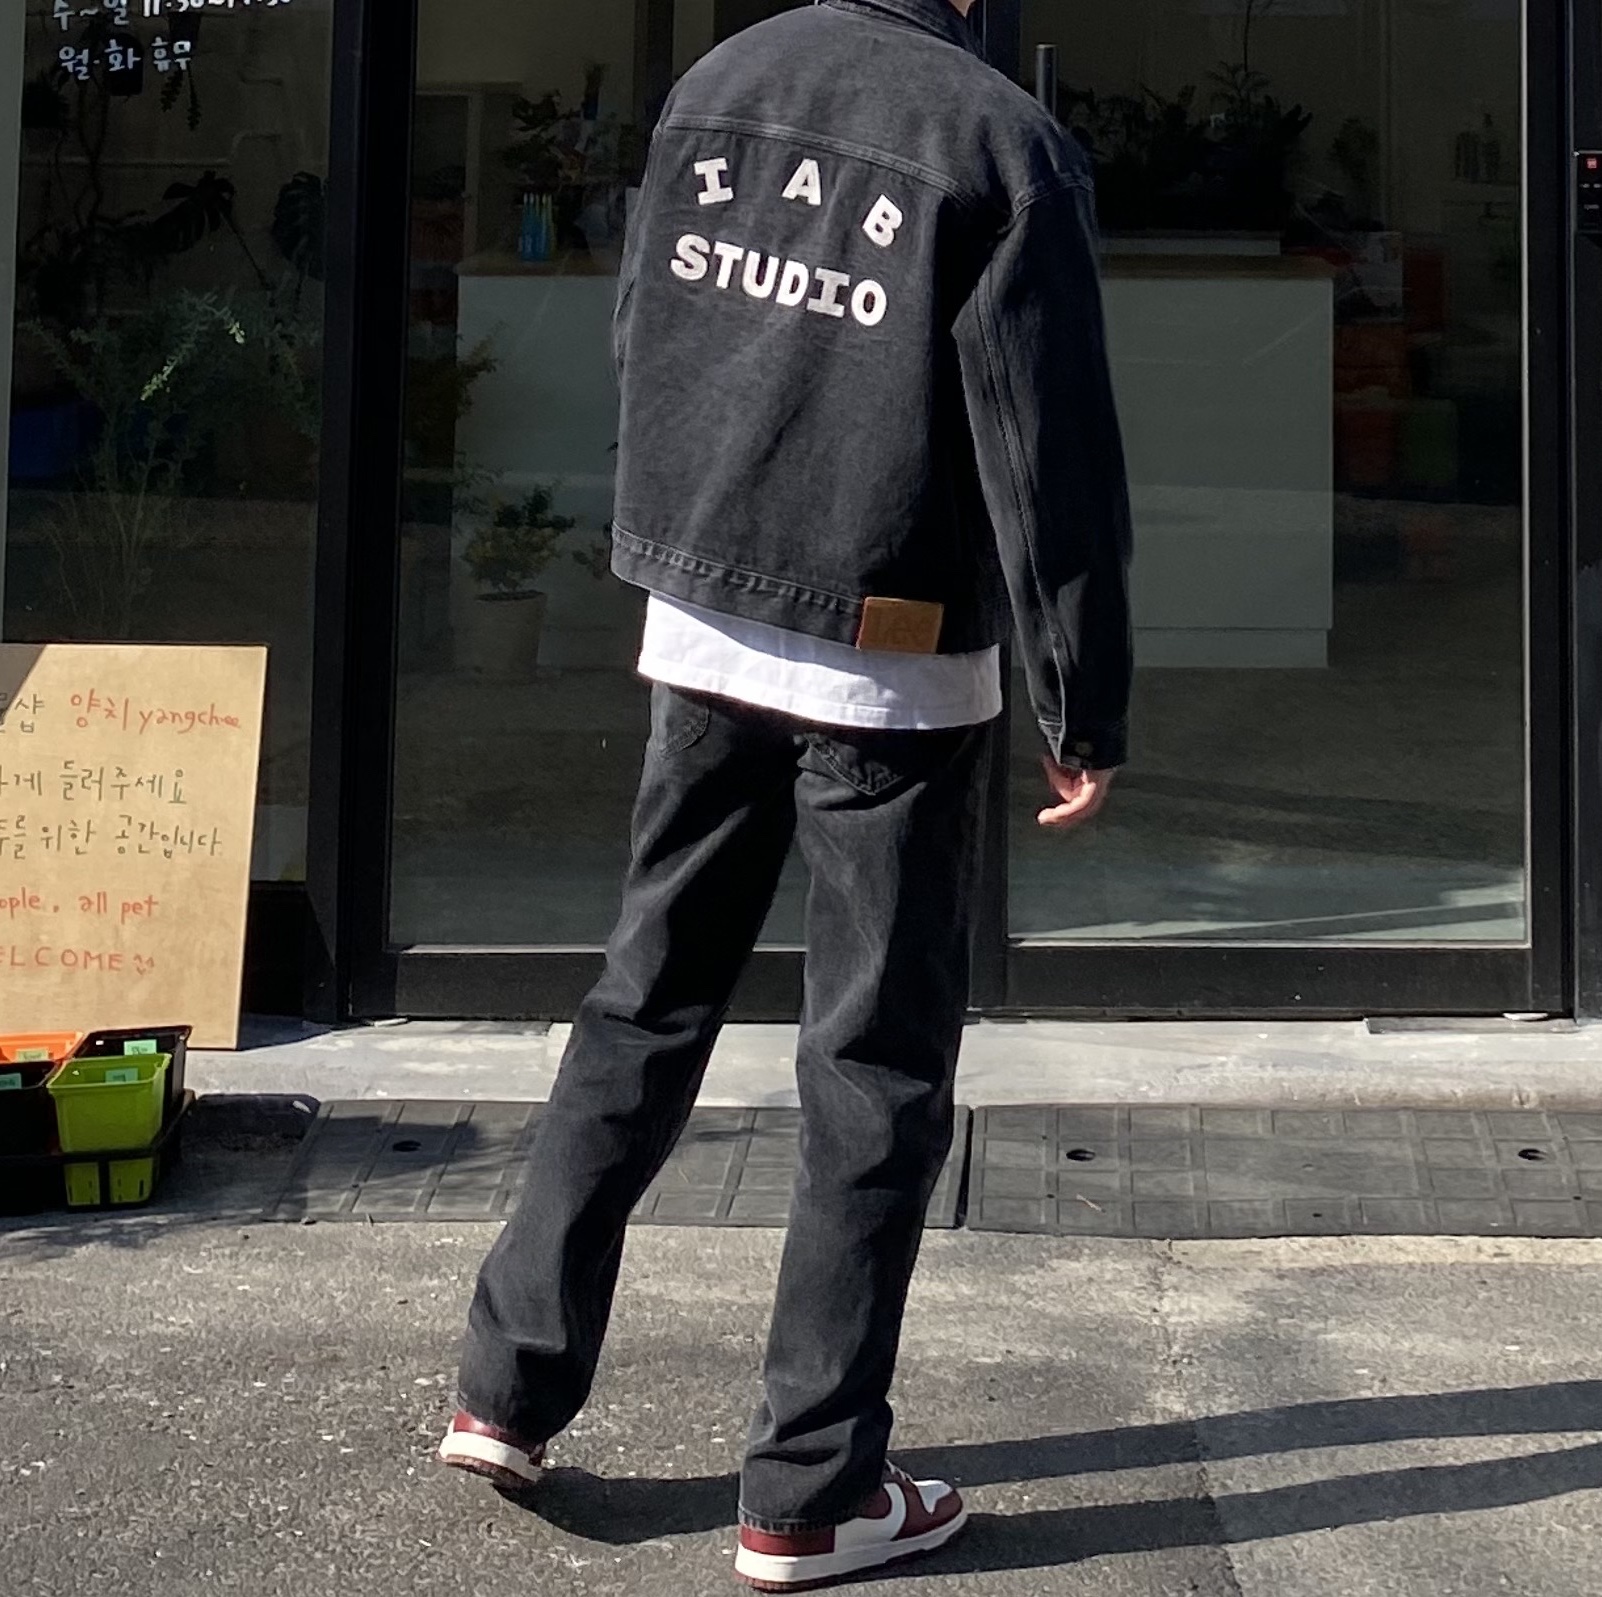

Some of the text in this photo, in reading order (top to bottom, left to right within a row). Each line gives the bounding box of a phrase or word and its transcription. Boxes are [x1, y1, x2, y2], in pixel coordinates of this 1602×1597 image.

[151, 36, 192, 72] 휴무
[670, 232, 887, 326] STUDIO
[70, 688, 129, 731] 양치
[40, 819, 97, 856] 위한
[78, 891, 108, 915] all
[121, 895, 159, 925] pet
